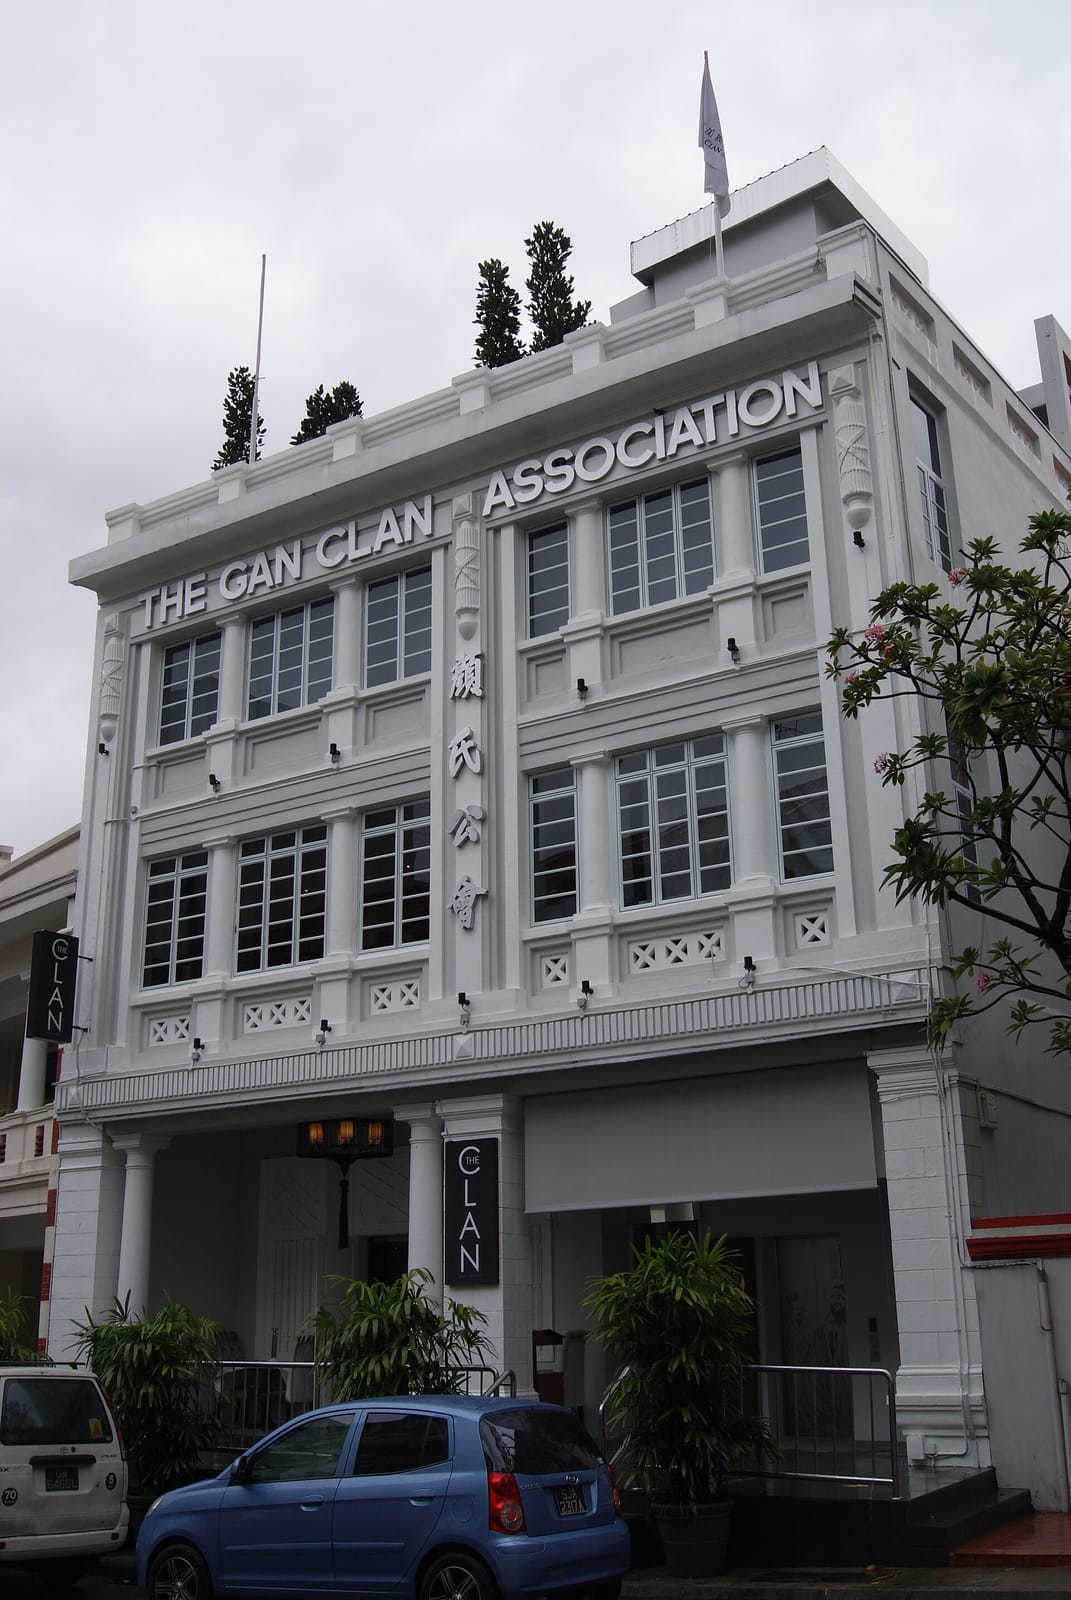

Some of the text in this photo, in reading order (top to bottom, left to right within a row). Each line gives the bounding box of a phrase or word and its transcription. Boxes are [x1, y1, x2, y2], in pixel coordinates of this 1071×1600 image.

[140, 361, 823, 628] THE GAN CLAN ASSOCIATION
[57, 945, 68, 954] THE
[48, 939, 69, 1032] CLAN
[465, 1156, 480, 1165] THE
[459, 1146, 480, 1273] CLAN
[108, 1474, 114, 1484] 5
[5, 1490, 16, 1500] 70
